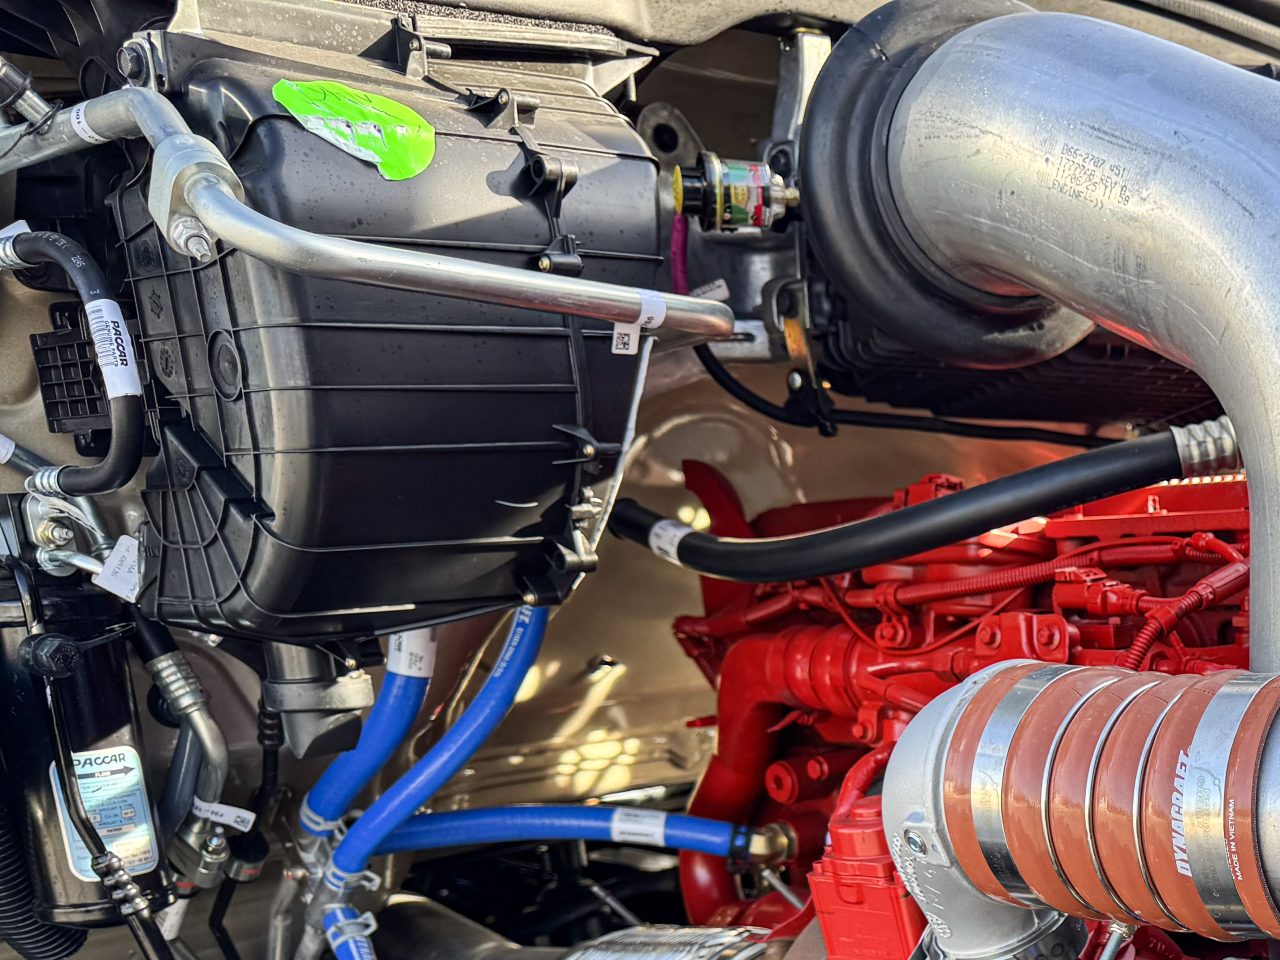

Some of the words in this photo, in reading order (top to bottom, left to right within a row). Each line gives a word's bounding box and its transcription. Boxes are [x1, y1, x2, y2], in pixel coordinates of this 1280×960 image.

[103, 319, 114, 346] GENUINE
[110, 347, 118, 367] PARTS
[110, 320, 128, 366] PACCAR
[72, 752, 126, 769] PACCAR
[1230, 841, 1236, 851] IN
[1232, 853, 1242, 880] MADE
